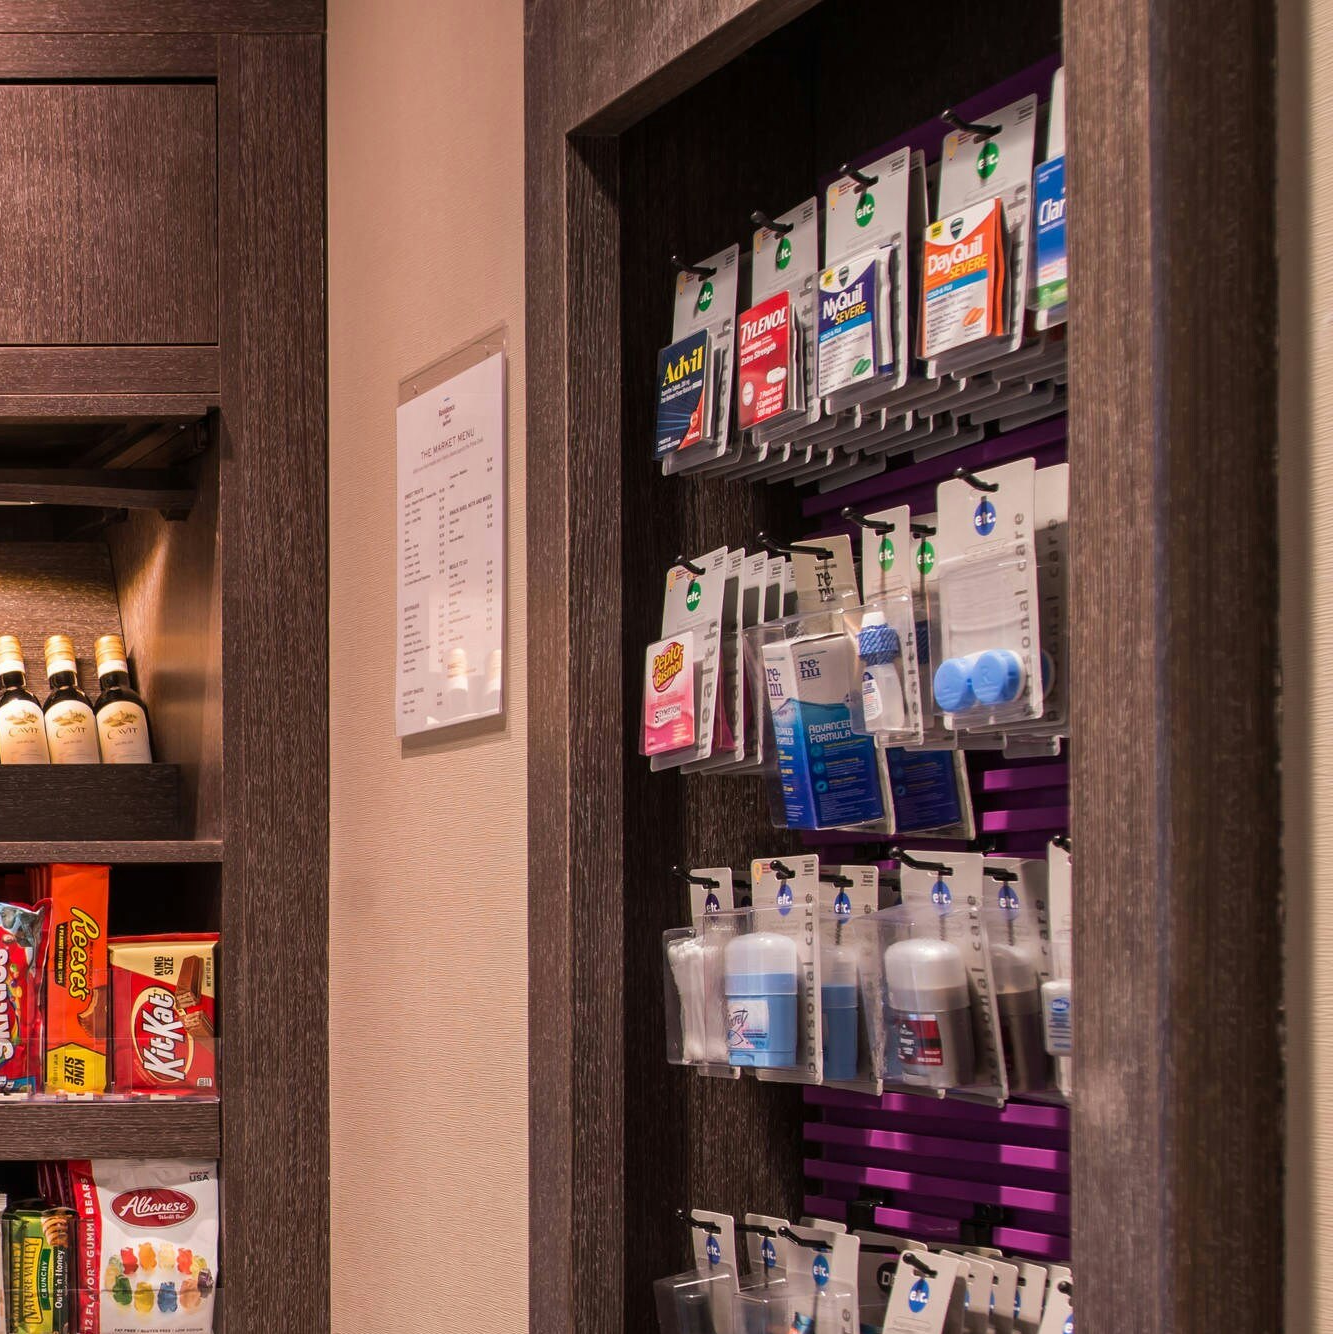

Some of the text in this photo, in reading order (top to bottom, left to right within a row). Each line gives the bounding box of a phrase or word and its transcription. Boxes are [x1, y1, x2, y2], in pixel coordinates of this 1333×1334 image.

[855, 203, 875, 219] etc.
[927, 234, 983, 275] DayQuil
[949, 254, 988, 279] SEVERE
[823, 282, 863, 319] NyQuil
[835, 302, 866, 325] SEVERE
[741, 306, 787, 345] TYLENOL
[663, 346, 703, 386] Advil
[421, 428, 475, 460] THE MARKET MENU
[974, 511, 996, 526] etc.
[1015, 512, 1024, 572] care
[878, 548, 894, 561] etc.
[917, 553, 934, 566] etc.
[687, 591, 701, 602] etc.
[653, 644, 684, 677] Pepto-
[655, 660, 684, 687] Bismol
[801, 668, 821, 679] nu
[809, 720, 851, 733] ADVANCED
[810, 731, 851, 743] FORMULA
[777, 892, 792, 904] etc.
[932, 891, 951, 904] etc.
[69, 907, 100, 1000] Reese's
[154, 956, 164, 976] KING
[164, 956, 174, 975] SIZE
[64, 1056, 74, 1086] SIZE
[74, 1058, 85, 1086] KING
[190, 1174, 210, 1182] USA
[120, 1196, 189, 1217] Albanese
[24, 1239, 42, 1323] NATURE VALLEY
[41, 1261, 49, 1298] CRUNCHY
